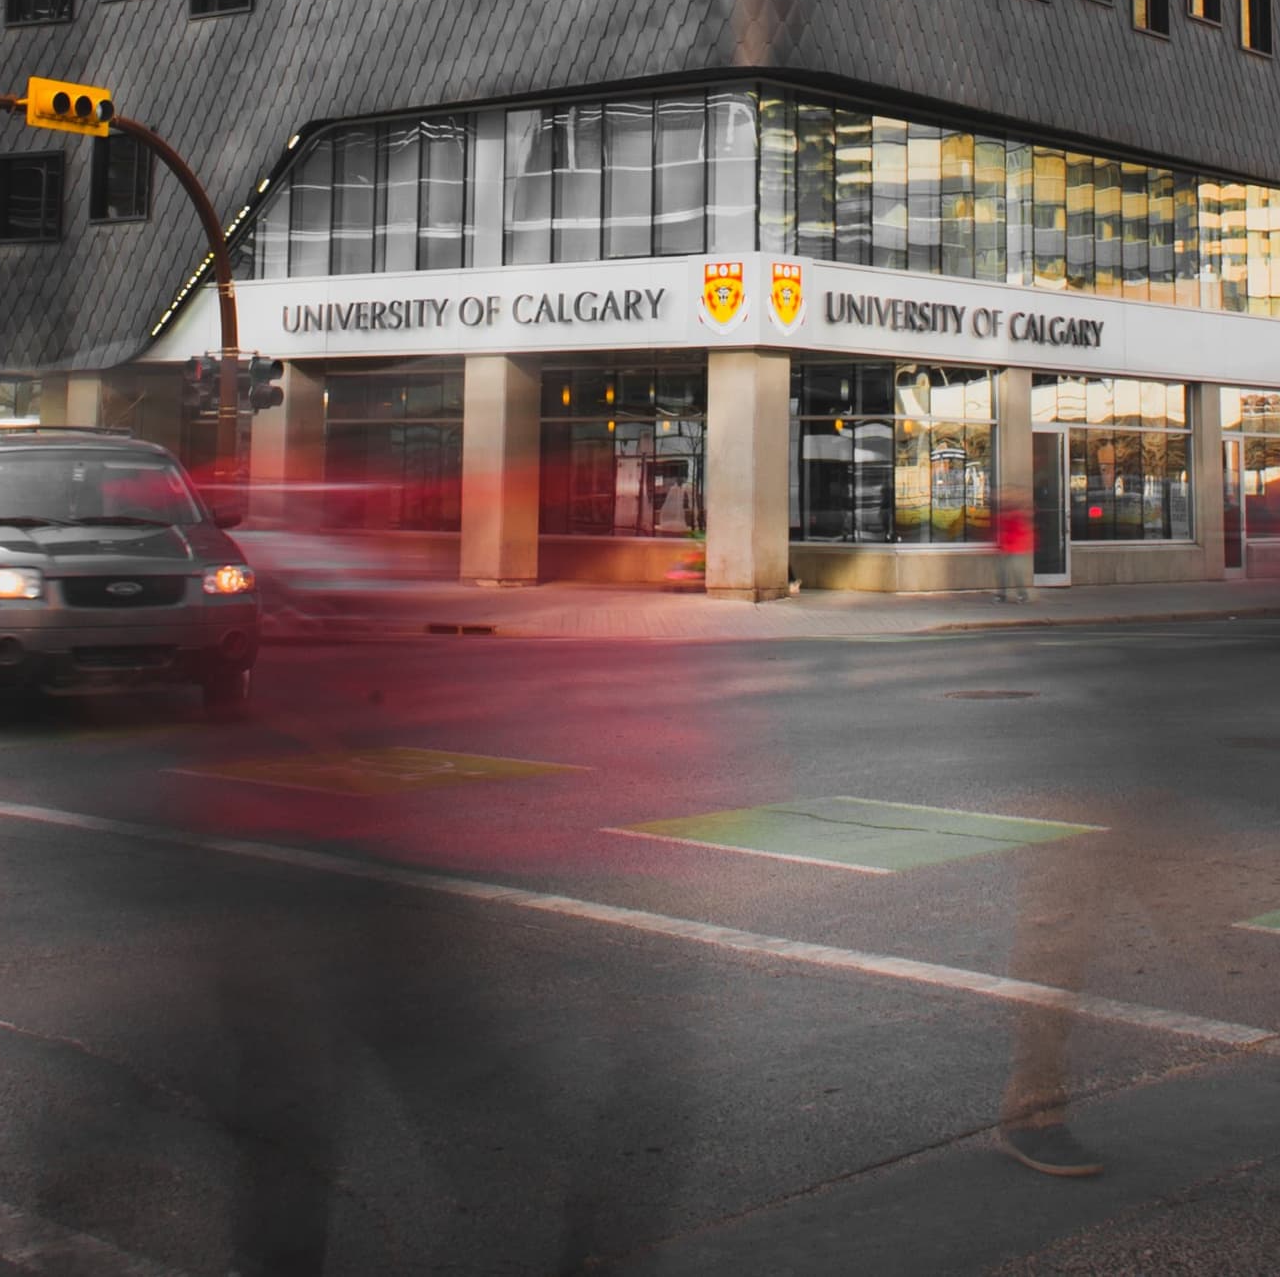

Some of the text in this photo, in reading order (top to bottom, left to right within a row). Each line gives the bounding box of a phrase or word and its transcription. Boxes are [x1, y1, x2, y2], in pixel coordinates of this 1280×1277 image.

[282, 288, 665, 334] UNIVERSITY OF CALGARY
[826, 291, 1105, 347] UNIVERSITY OF CALGARY
